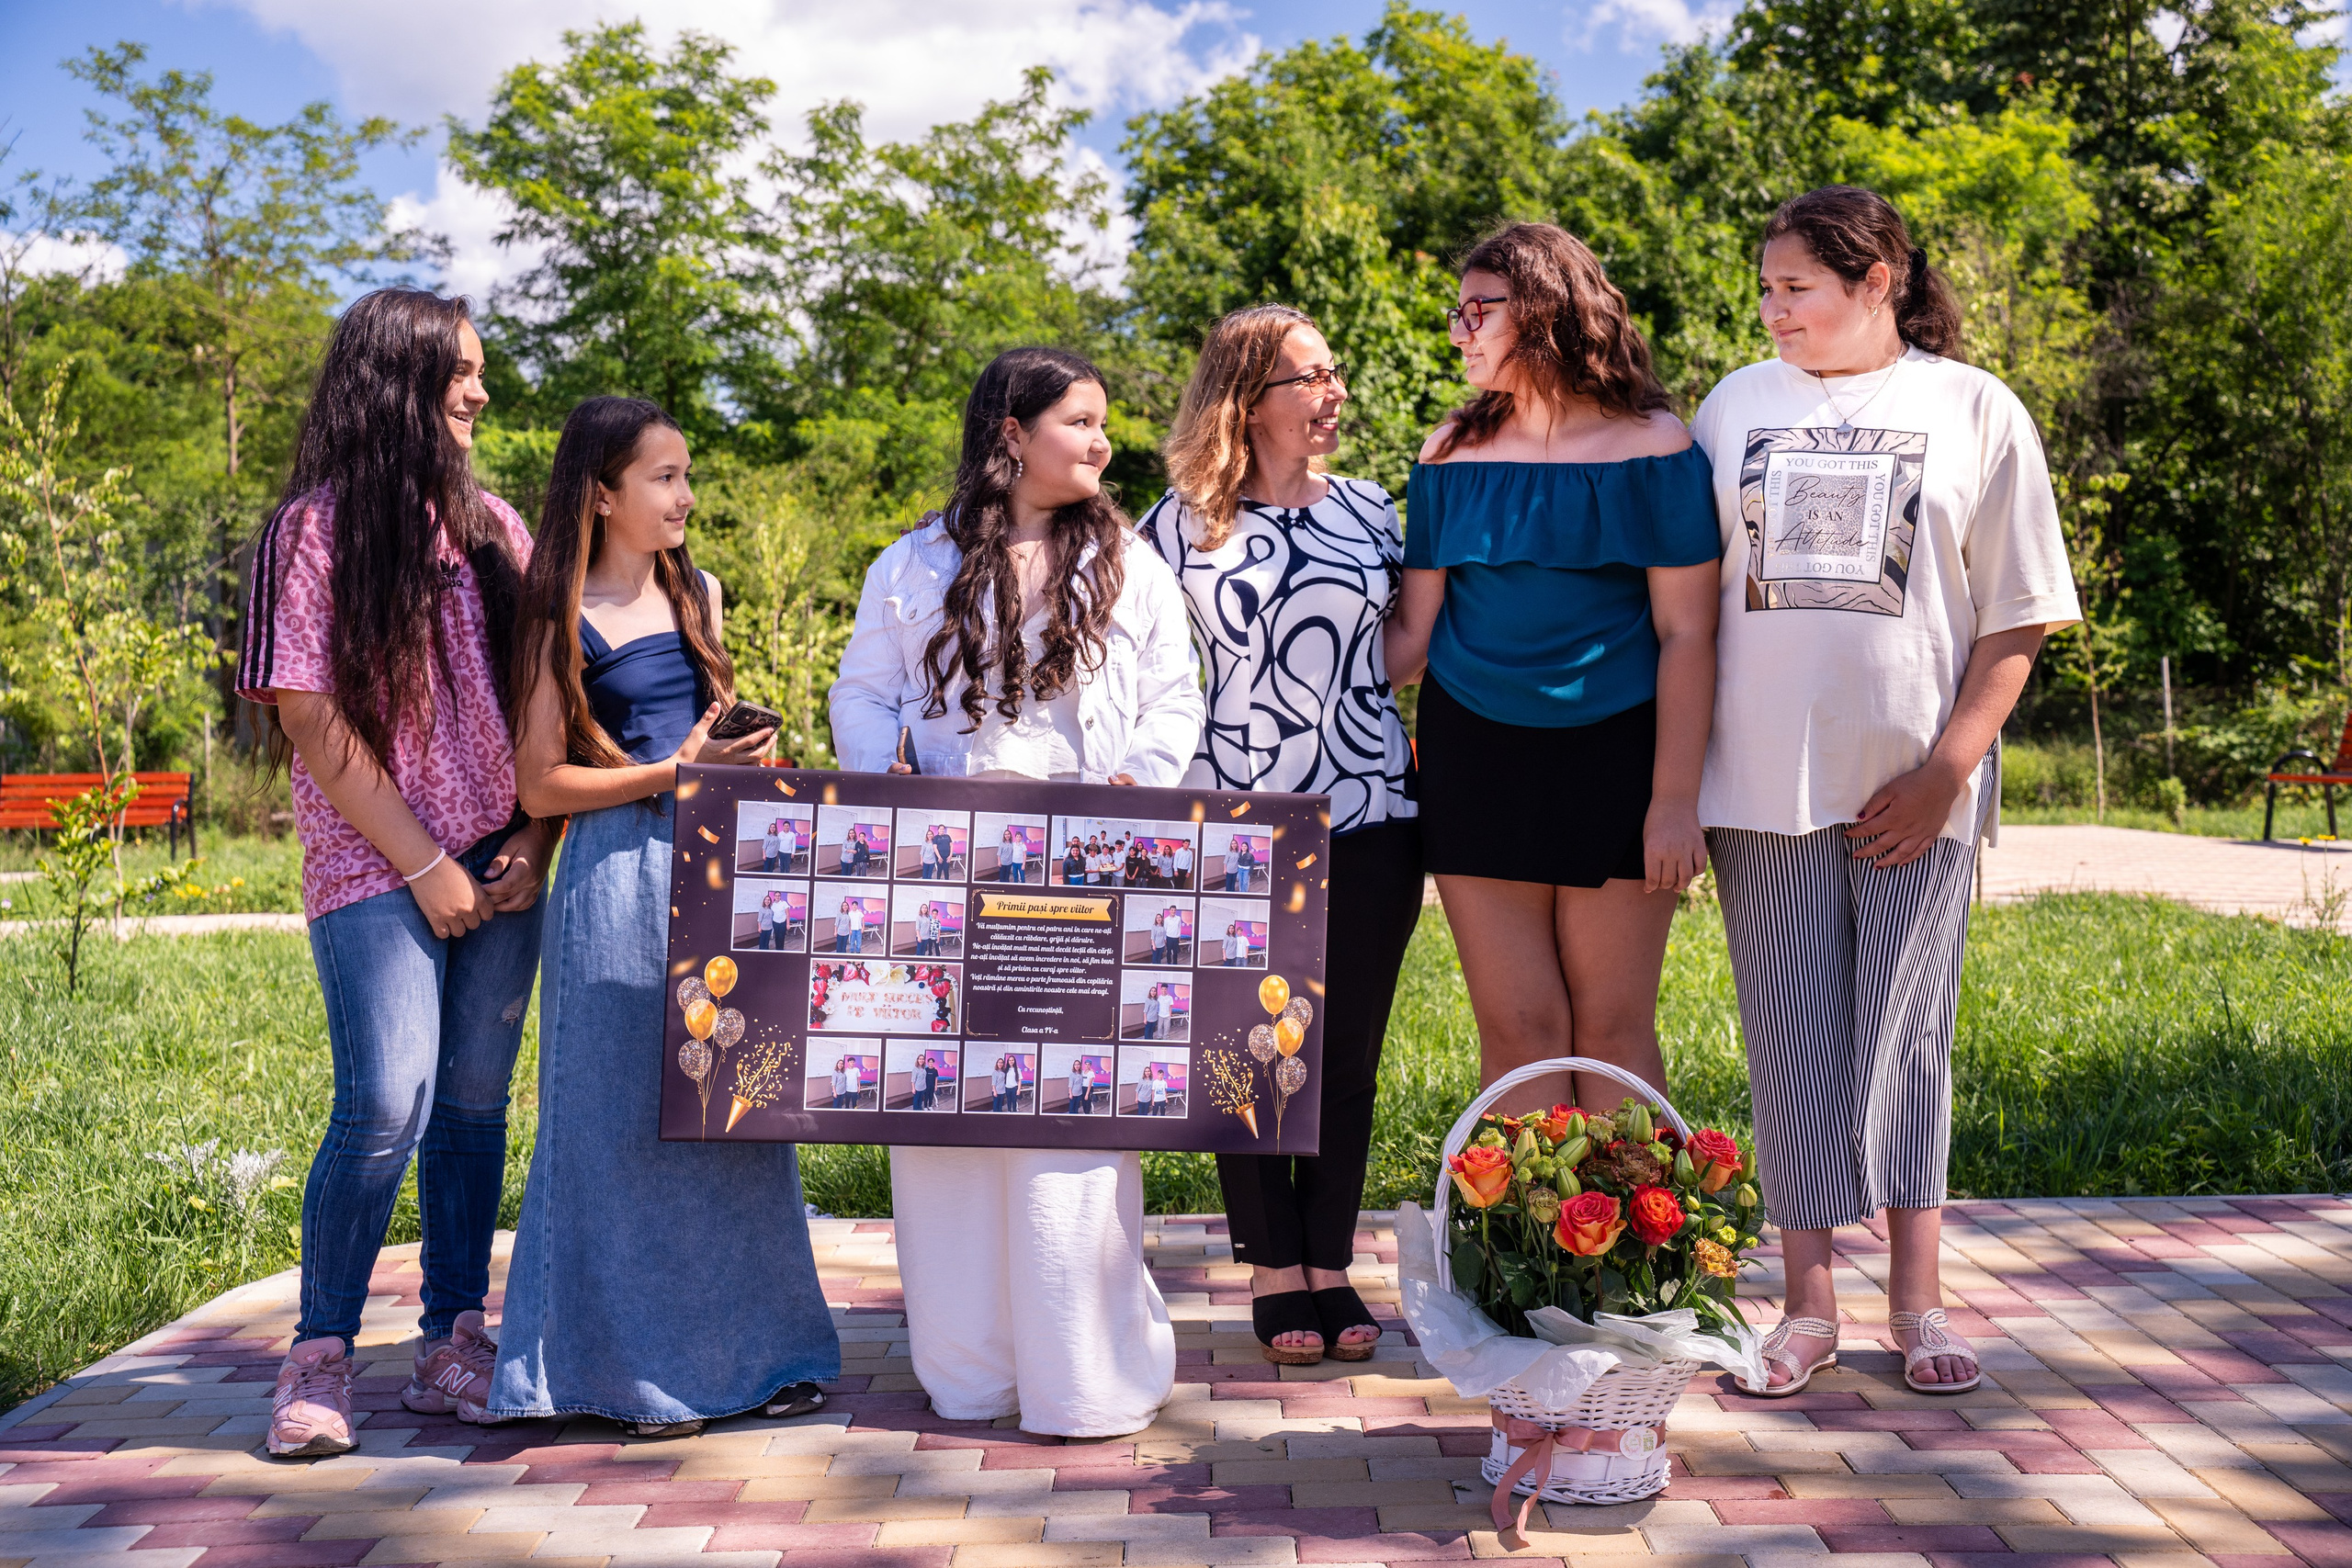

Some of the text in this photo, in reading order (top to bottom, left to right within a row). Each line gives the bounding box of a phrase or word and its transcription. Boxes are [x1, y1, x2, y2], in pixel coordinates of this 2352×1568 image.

[1786, 458, 1878, 470] YOU GOT THIS
[1769, 470, 1781, 498] THIS
[1784, 475, 1866, 508] Beauty
[1808, 510, 1843, 522] IS AN
[1865, 473, 1886, 562] YOU GOT THIS
[1775, 521, 1870, 551] Attitude
[1804, 562, 1832, 573] GOT
[1837, 564, 1864, 575] YOU
[997, 901, 1094, 915] Primii pași spre viitor
[435, 1362, 477, 1396] N
